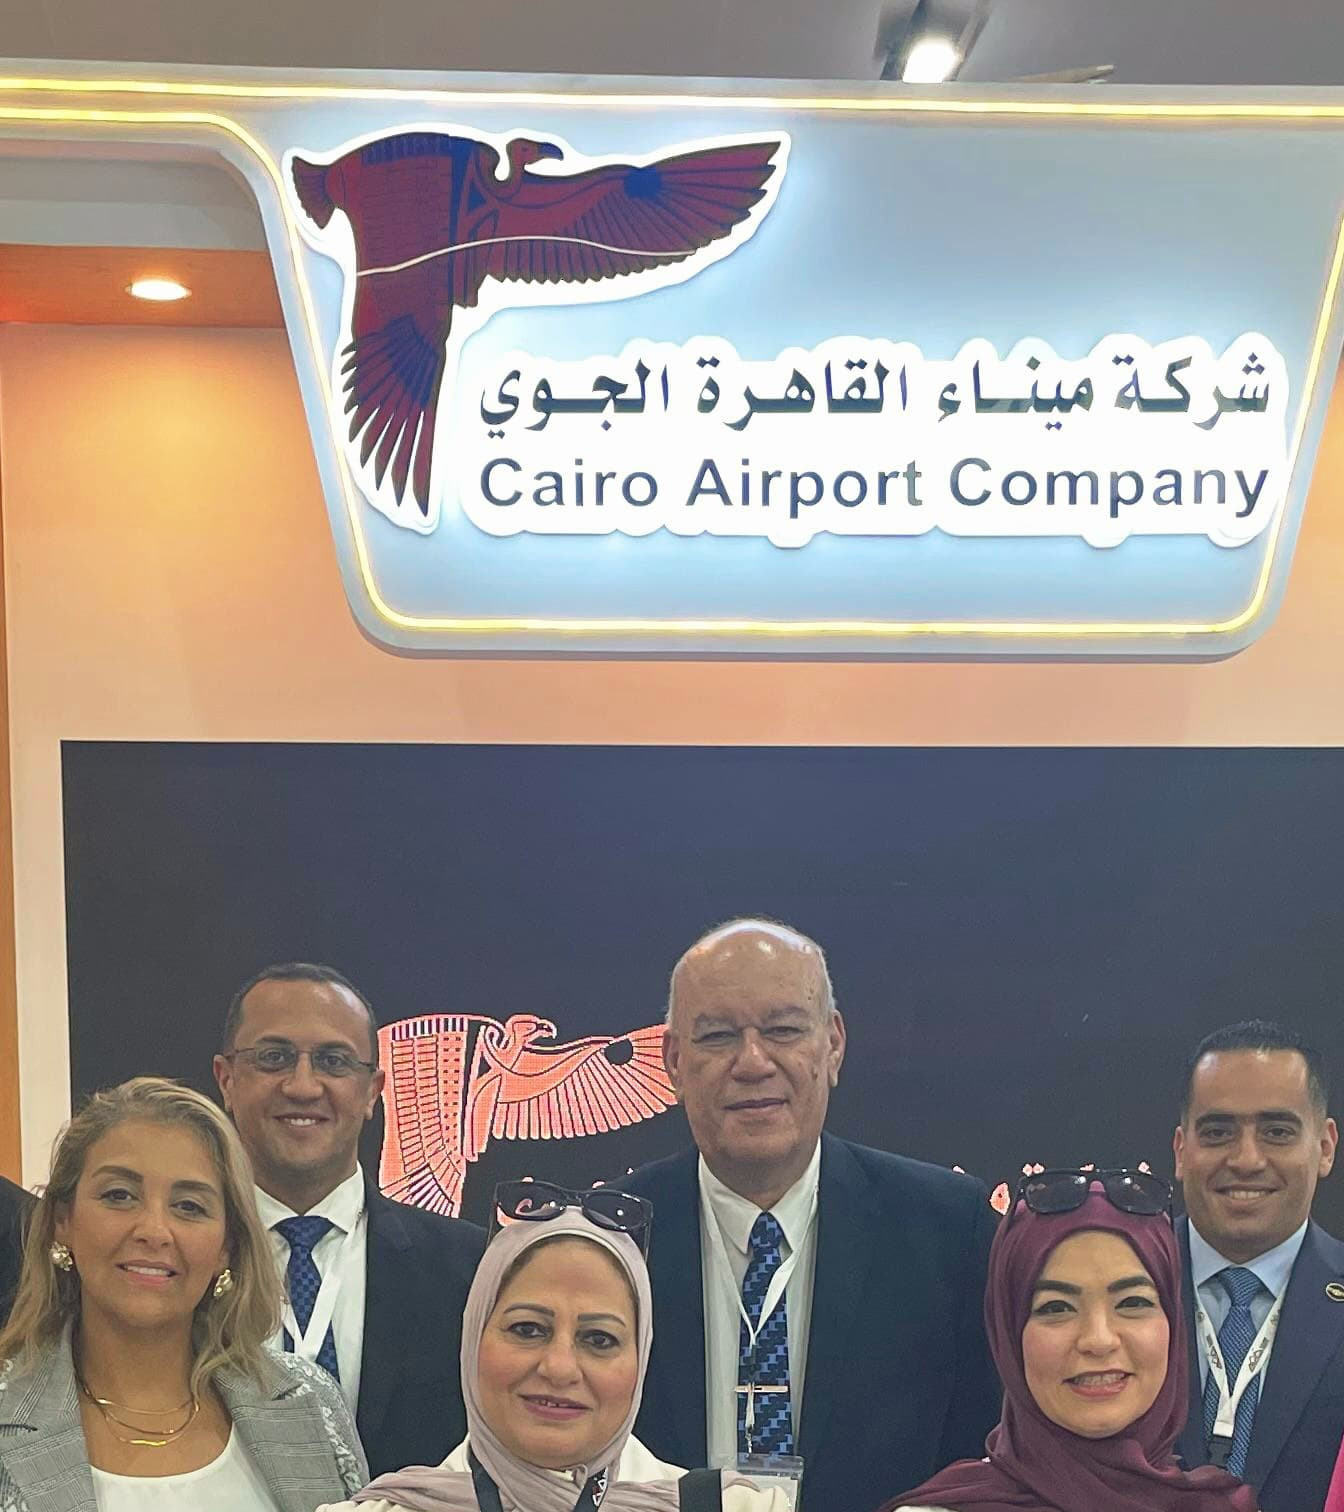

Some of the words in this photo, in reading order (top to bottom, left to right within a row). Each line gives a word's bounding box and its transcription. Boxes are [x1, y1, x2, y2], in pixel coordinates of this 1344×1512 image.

[480, 357, 669, 439] الجوي
[695, 355, 907, 432] القاهرة
[937, 354, 1094, 431] ميناء
[1112, 350, 1269, 430] شركة
[480, 457, 658, 506] Cairo
[686, 457, 922, 519] Airport
[950, 457, 1268, 518] Company
